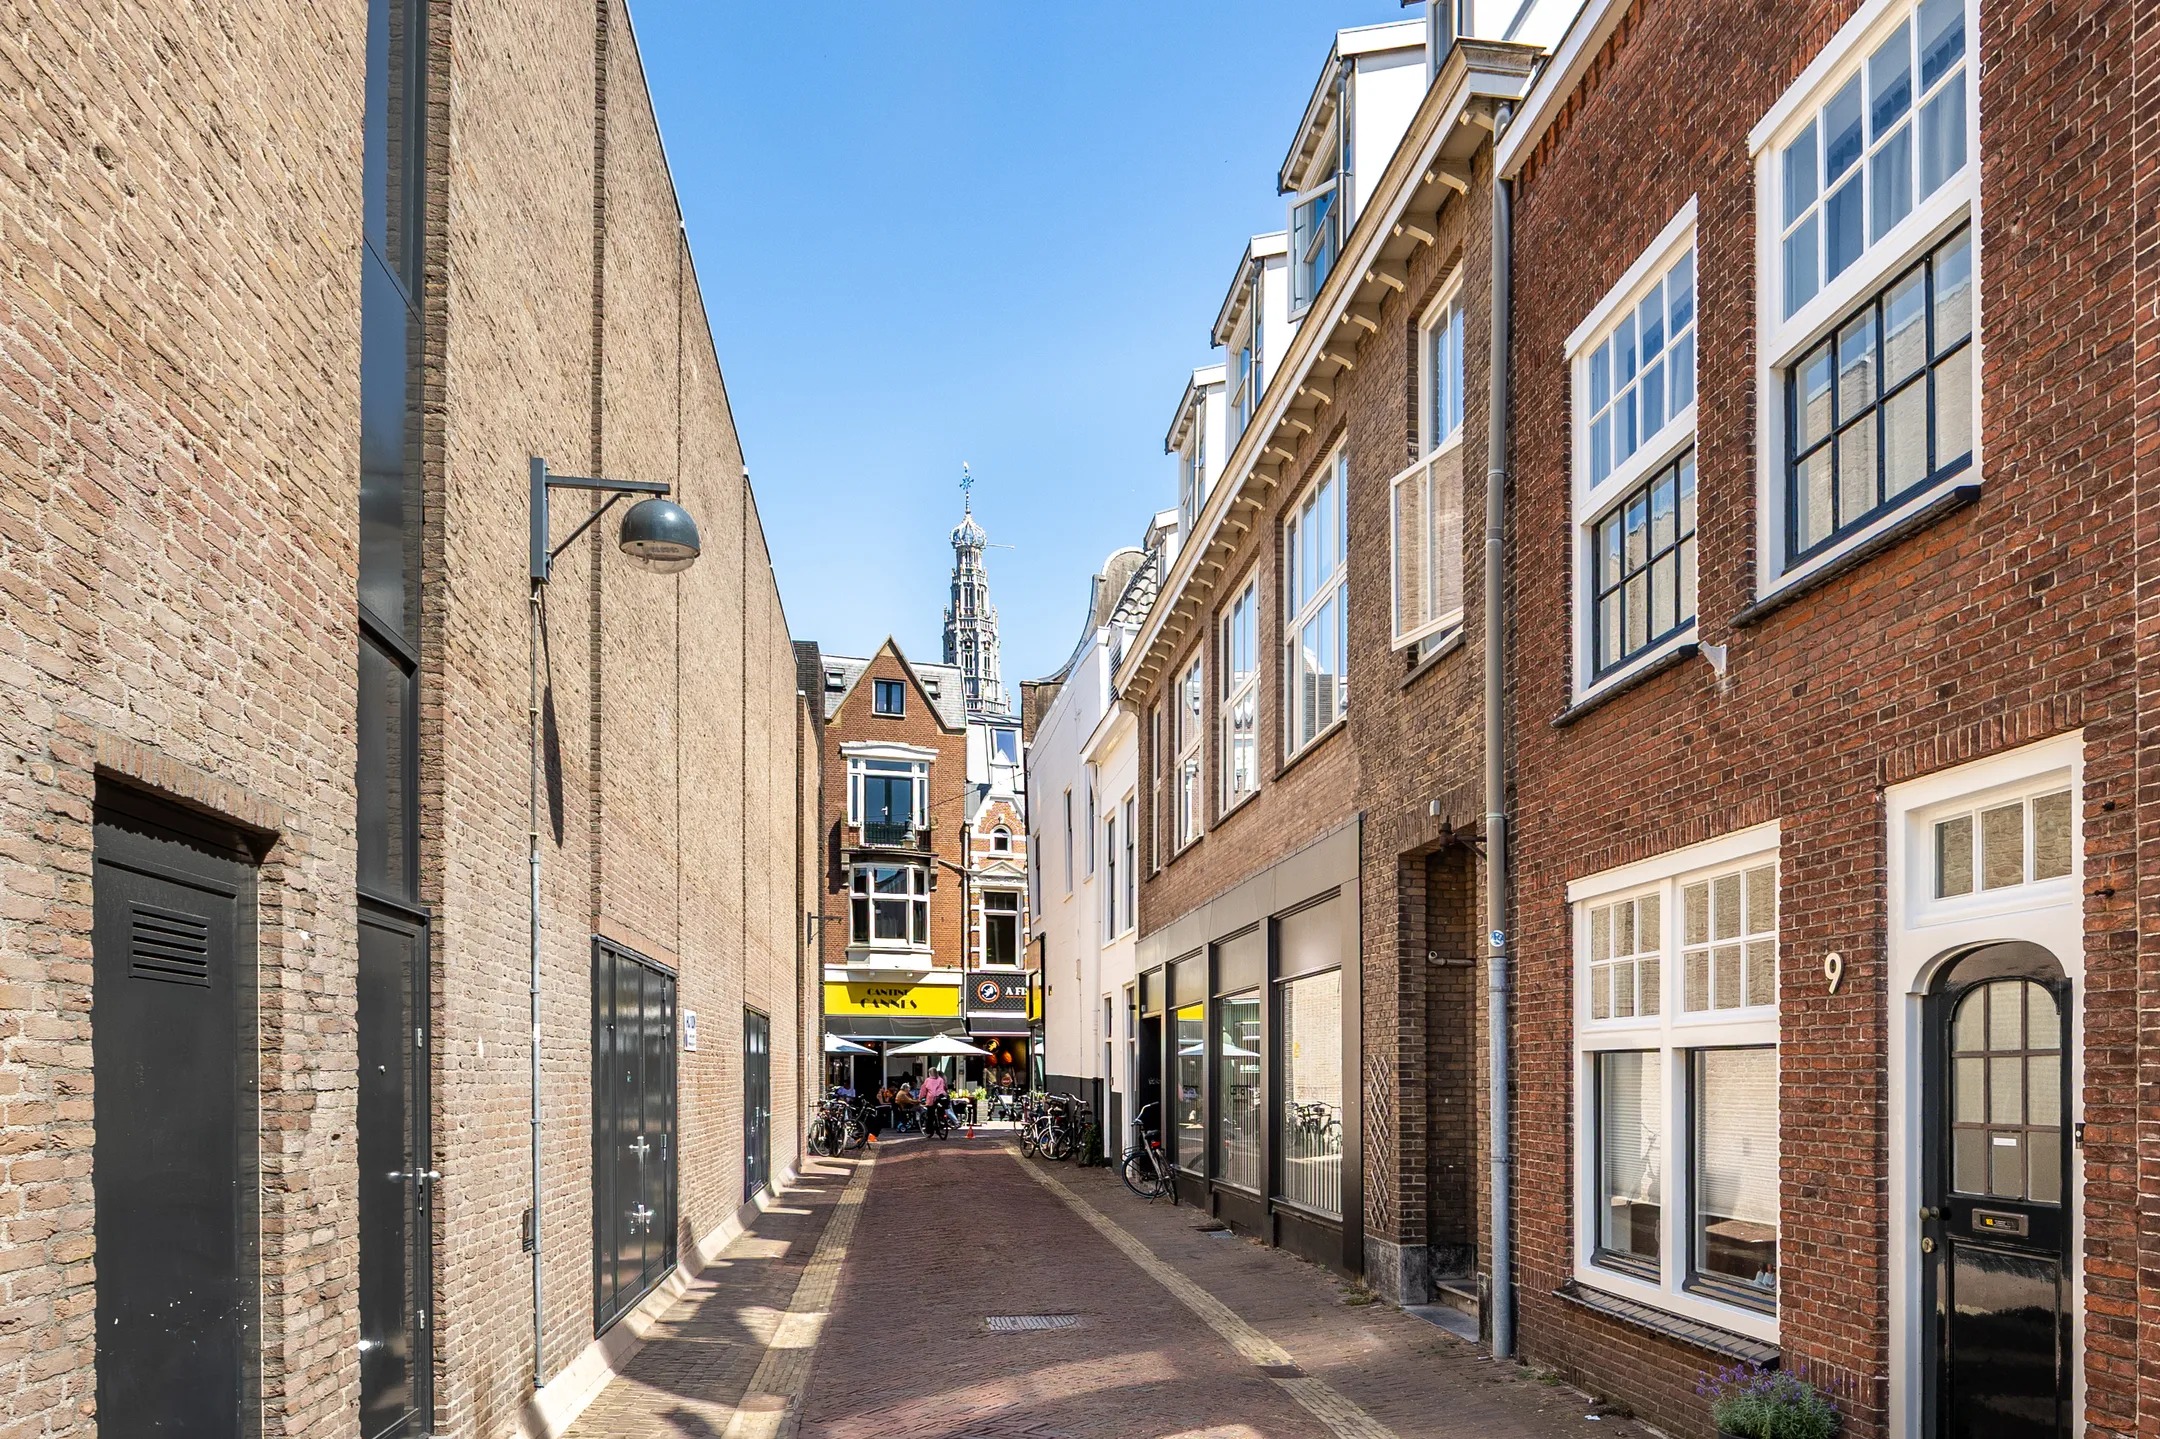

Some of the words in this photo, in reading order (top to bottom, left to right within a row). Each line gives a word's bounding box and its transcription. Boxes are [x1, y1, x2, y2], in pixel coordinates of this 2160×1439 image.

[1824, 952, 1843, 995] 9
[867, 988, 909, 996] CANTINE
[1005, 986, 1014, 996] A
[860, 998, 918, 1009] CANNES
